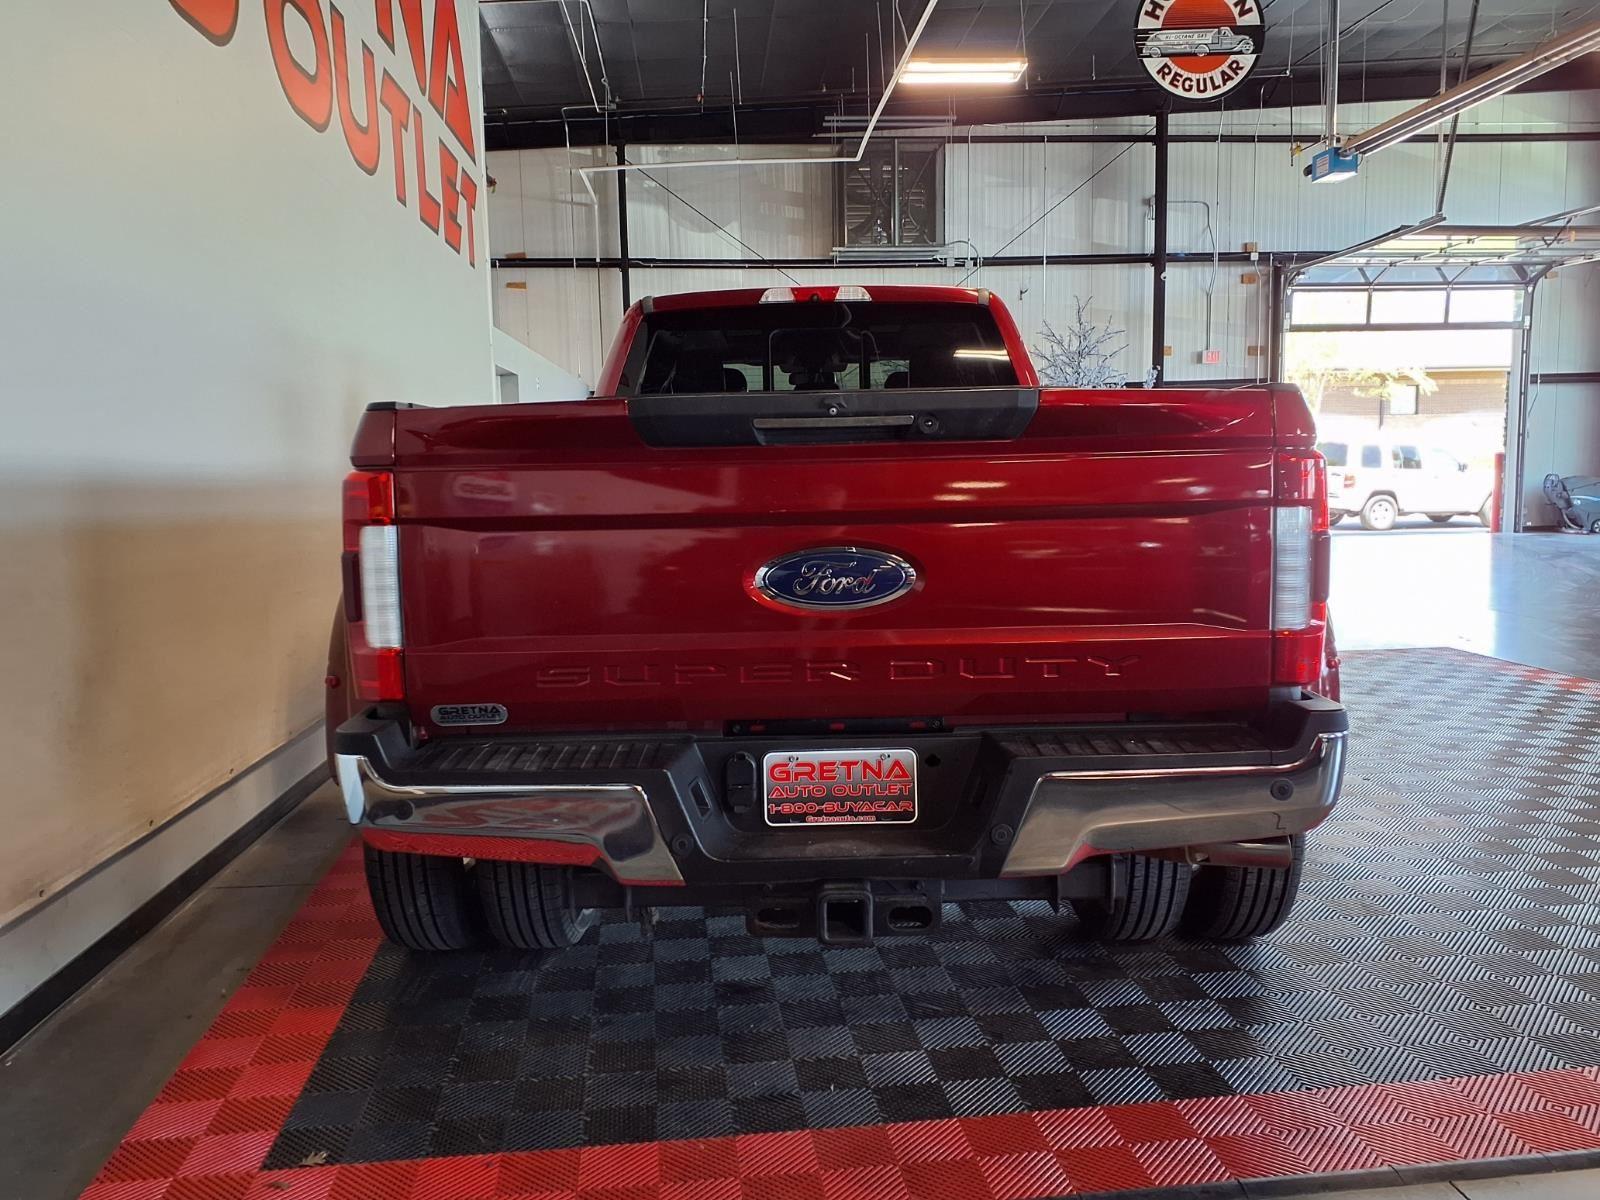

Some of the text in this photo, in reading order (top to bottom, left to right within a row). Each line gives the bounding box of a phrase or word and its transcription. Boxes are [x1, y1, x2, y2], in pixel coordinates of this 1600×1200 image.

[1156, 59, 1245, 94] REGULAR
[263, 0, 477, 269] OUTLET
[793, 560, 880, 595] Ford
[535, 655, 1140, 690] SUPER DUTY
[438, 705, 501, 716] GRETNA
[768, 759, 913, 783] GRETNA
[768, 783, 913, 799] AUTO OUTLET
[768, 801, 914, 815] 1-800-BUYACAR
